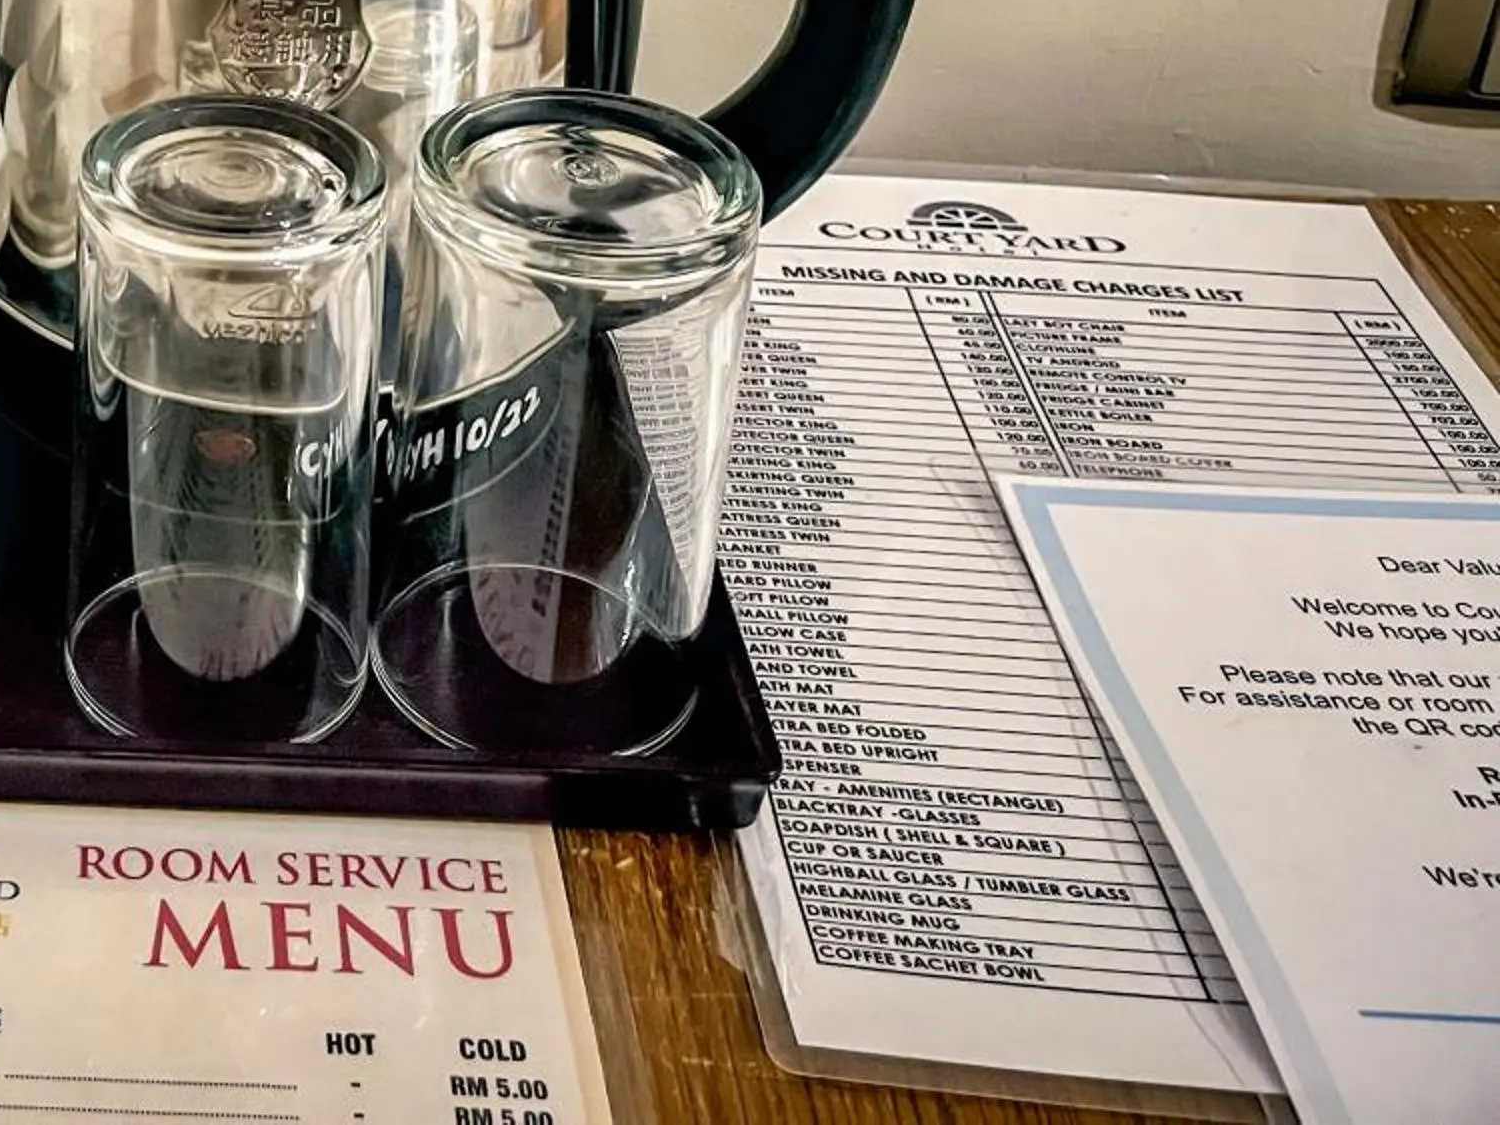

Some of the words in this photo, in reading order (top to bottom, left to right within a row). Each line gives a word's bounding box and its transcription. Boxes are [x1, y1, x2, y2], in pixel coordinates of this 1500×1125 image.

[758, 287, 795, 297] ITEM
[781, 265, 886, 283] MISSING
[893, 270, 948, 284] AND
[953, 273, 1068, 292] DAMAGE
[1074, 280, 1191, 299] CHARGES
[1196, 287, 1245, 303] LIST
[1148, 308, 1187, 318] ITEM
[731, 484, 801, 497] SKIRTING
[801, 474, 855, 486] QUEEN
[751, 560, 818, 573] RUNNER
[1378, 555, 1440, 575] Dear
[772, 577, 831, 590] PILLOW
[769, 594, 829, 606] PILLOW
[1291, 596, 1418, 619] Welcome
[1422, 601, 1449, 618] to
[787, 611, 848, 625] PILLOW
[800, 628, 847, 642] CASE
[1324, 620, 1374, 640] We
[1378, 621, 1448, 646] hope
[786, 645, 845, 660] TOWEL
[799, 664, 859, 678] TOWEL
[1219, 664, 1316, 686] Please
[1323, 669, 1383, 688] note
[1391, 667, 1445, 689] that
[1448, 673, 1493, 690] our
[797, 682, 834, 695] MAT
[823, 703, 861, 716] MAT
[1178, 685, 1227, 705] For
[1235, 689, 1381, 712] assistance
[1388, 695, 1415, 712] or
[1421, 697, 1496, 714] room
[817, 721, 850, 736] BED
[856, 724, 926, 741] FOLDED
[1352, 717, 1400, 736] the
[1404, 718, 1455, 737] QR
[822, 742, 856, 756] BED
[861, 745, 939, 762] UPRIGHT
[776, 798, 884, 819] BLACKTRAY
[837, 782, 933, 803] AMENITIES
[937, 789, 1065, 815] (RECTANGLE)
[781, 819, 877, 839] SOAPDISH
[896, 828, 951, 846] SHELL
[973, 835, 1051, 855] SQUARE
[787, 840, 826, 855] CUP
[833, 843, 862, 859] OR
[866, 846, 944, 866] SAUCER
[76, 844, 258, 886] ROOM
[276, 851, 509, 895] SERVICE
[793, 861, 889, 884] HIGHBALL
[893, 870, 957, 889] GLASS
[975, 876, 1062, 897] TUMBLER
[1067, 884, 1132, 903] GLASS
[799, 883, 904, 905] MELAMINE
[908, 893, 973, 911] GLASS
[806, 904, 905, 926] DRINKING
[911, 914, 961, 932] MUG
[142, 897, 514, 981] MENU
[812, 925, 889, 946] COFFEE
[893, 932, 980, 955] MAKING
[985, 943, 1036, 960] TRAY
[819, 945, 897, 967] COFFEE
[900, 953, 979, 975] SACHET
[985, 962, 1046, 982] BOWL
[325, 1032, 376, 1056] HOT
[459, 1037, 527, 1062] COLD
[450, 1075, 489, 1097] RM
[496, 1078, 549, 1100] 5.00
